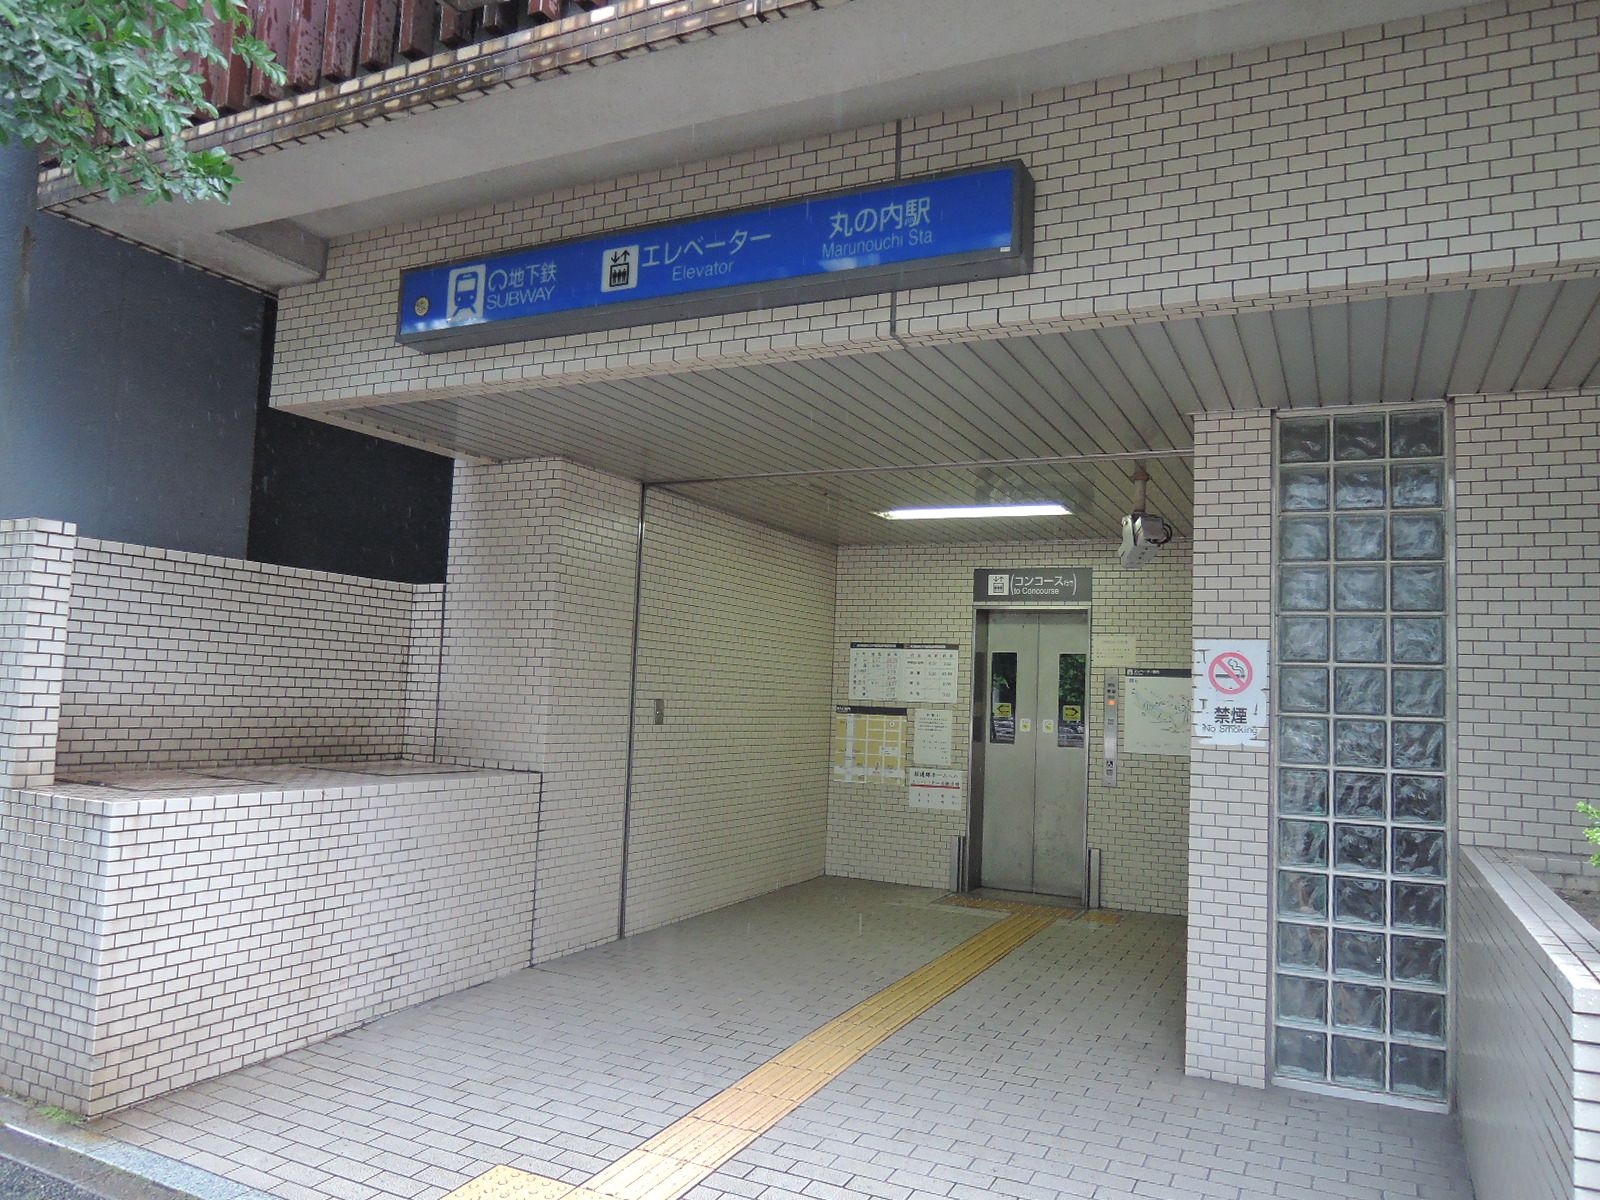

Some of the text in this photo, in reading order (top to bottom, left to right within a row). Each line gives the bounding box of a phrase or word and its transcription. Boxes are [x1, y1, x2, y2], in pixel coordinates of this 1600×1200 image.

[828, 196, 931, 240] 丸の内駅
[642, 229, 772, 267] エレベーター
[821, 235, 904, 259] Marunouchi
[508, 263, 557, 290] 地下鉄
[671, 258, 734, 282] Elevator
[486, 286, 555, 310] SUBWAY
[1214, 707, 1248, 724] 禁煙
[1202, 725, 1257, 735] No Smoking
